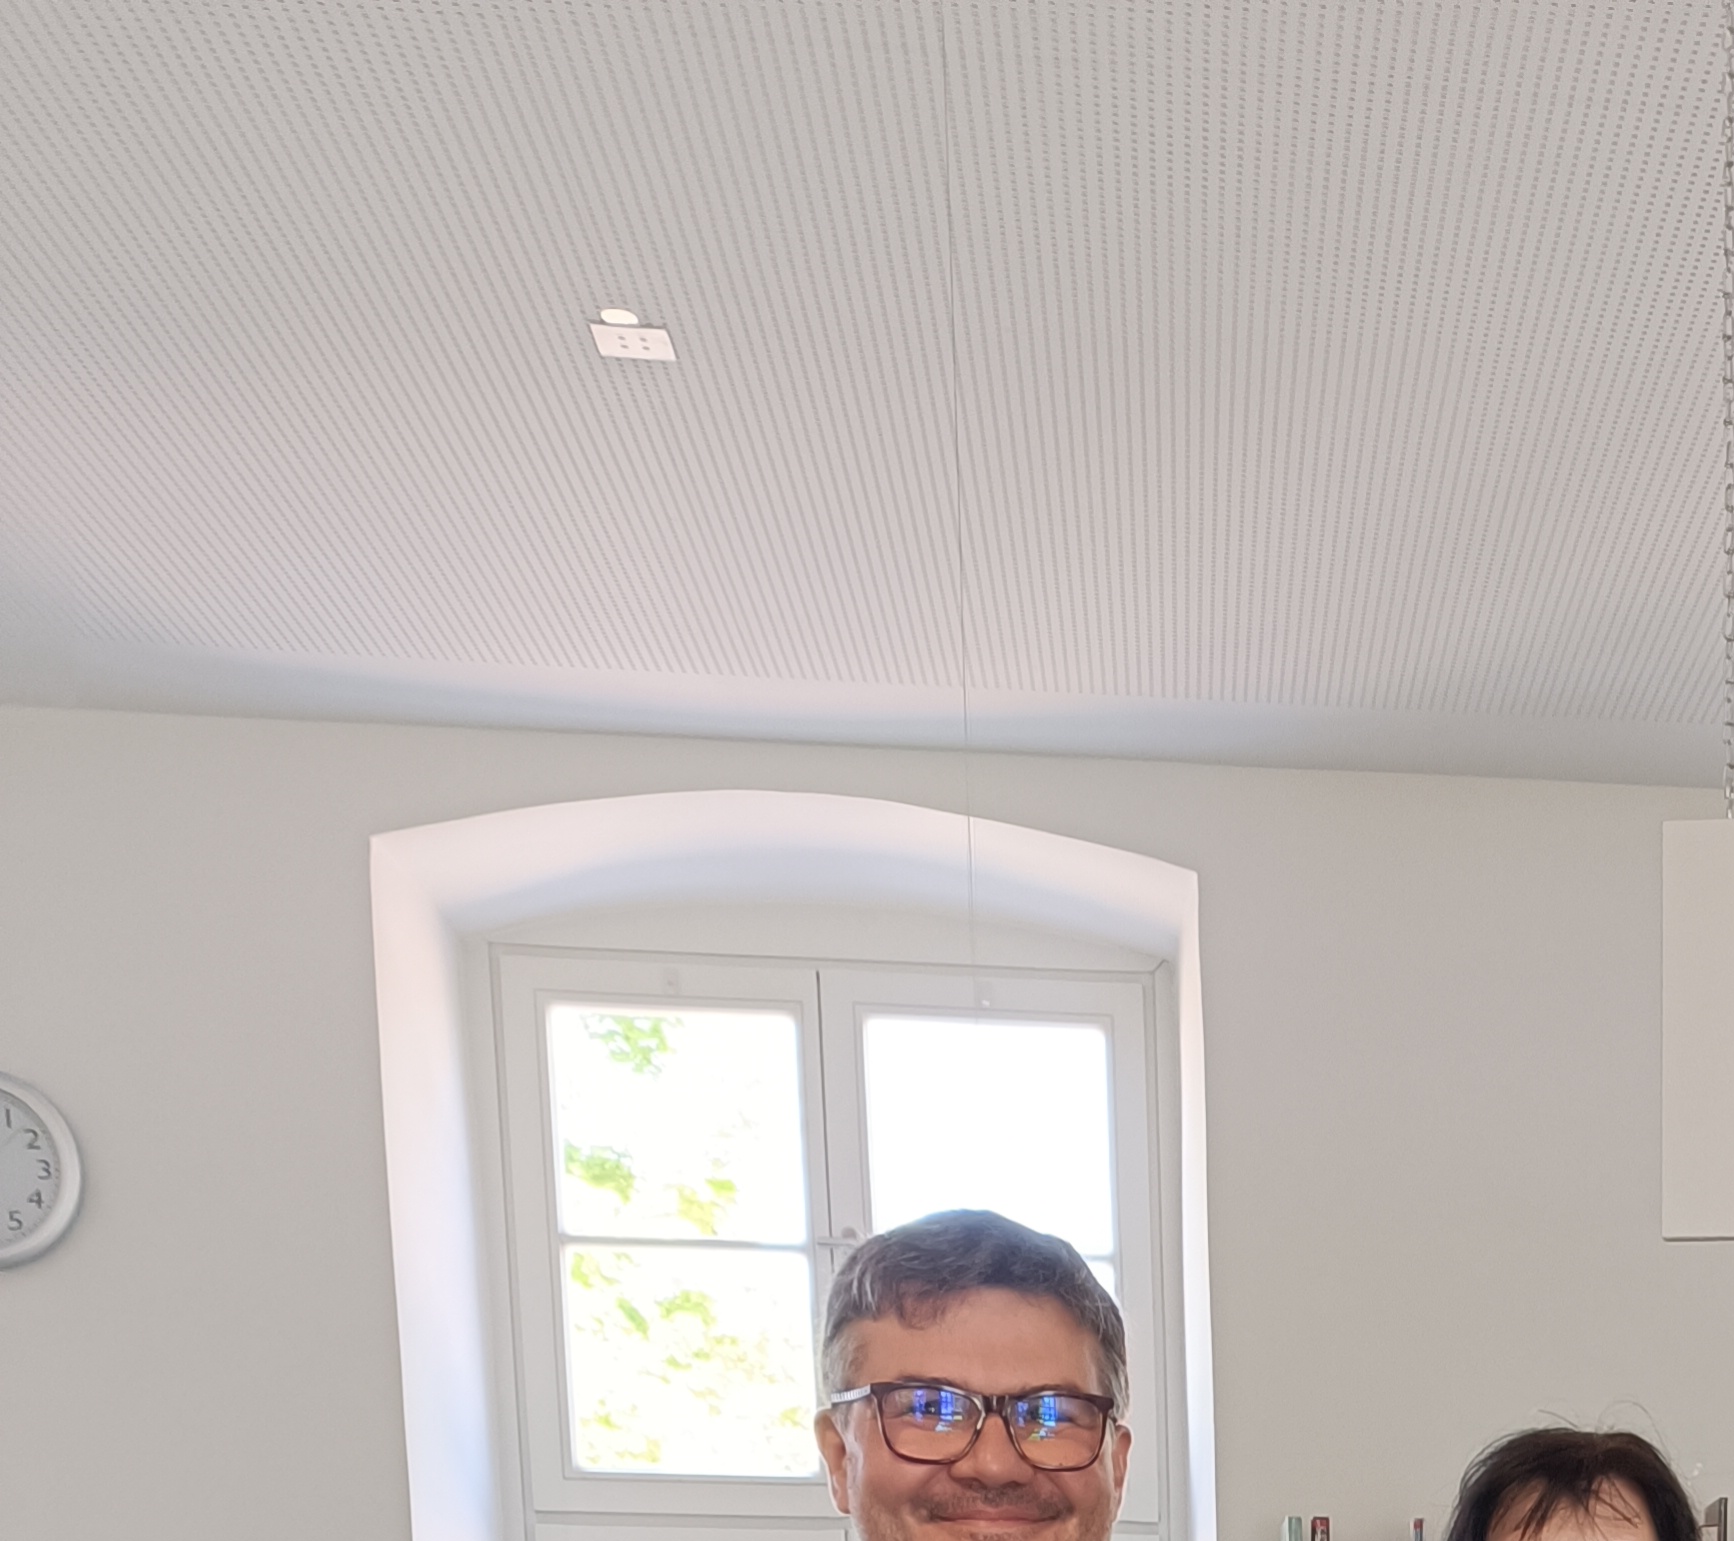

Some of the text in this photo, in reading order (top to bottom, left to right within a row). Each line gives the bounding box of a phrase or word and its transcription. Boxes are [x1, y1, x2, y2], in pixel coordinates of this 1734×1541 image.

[5, 1108, 12, 1129] 1
[23, 1129, 41, 1150] 2
[36, 1159, 51, 1180] 3
[27, 1188, 43, 1209] 4
[8, 1210, 23, 1231] 5
